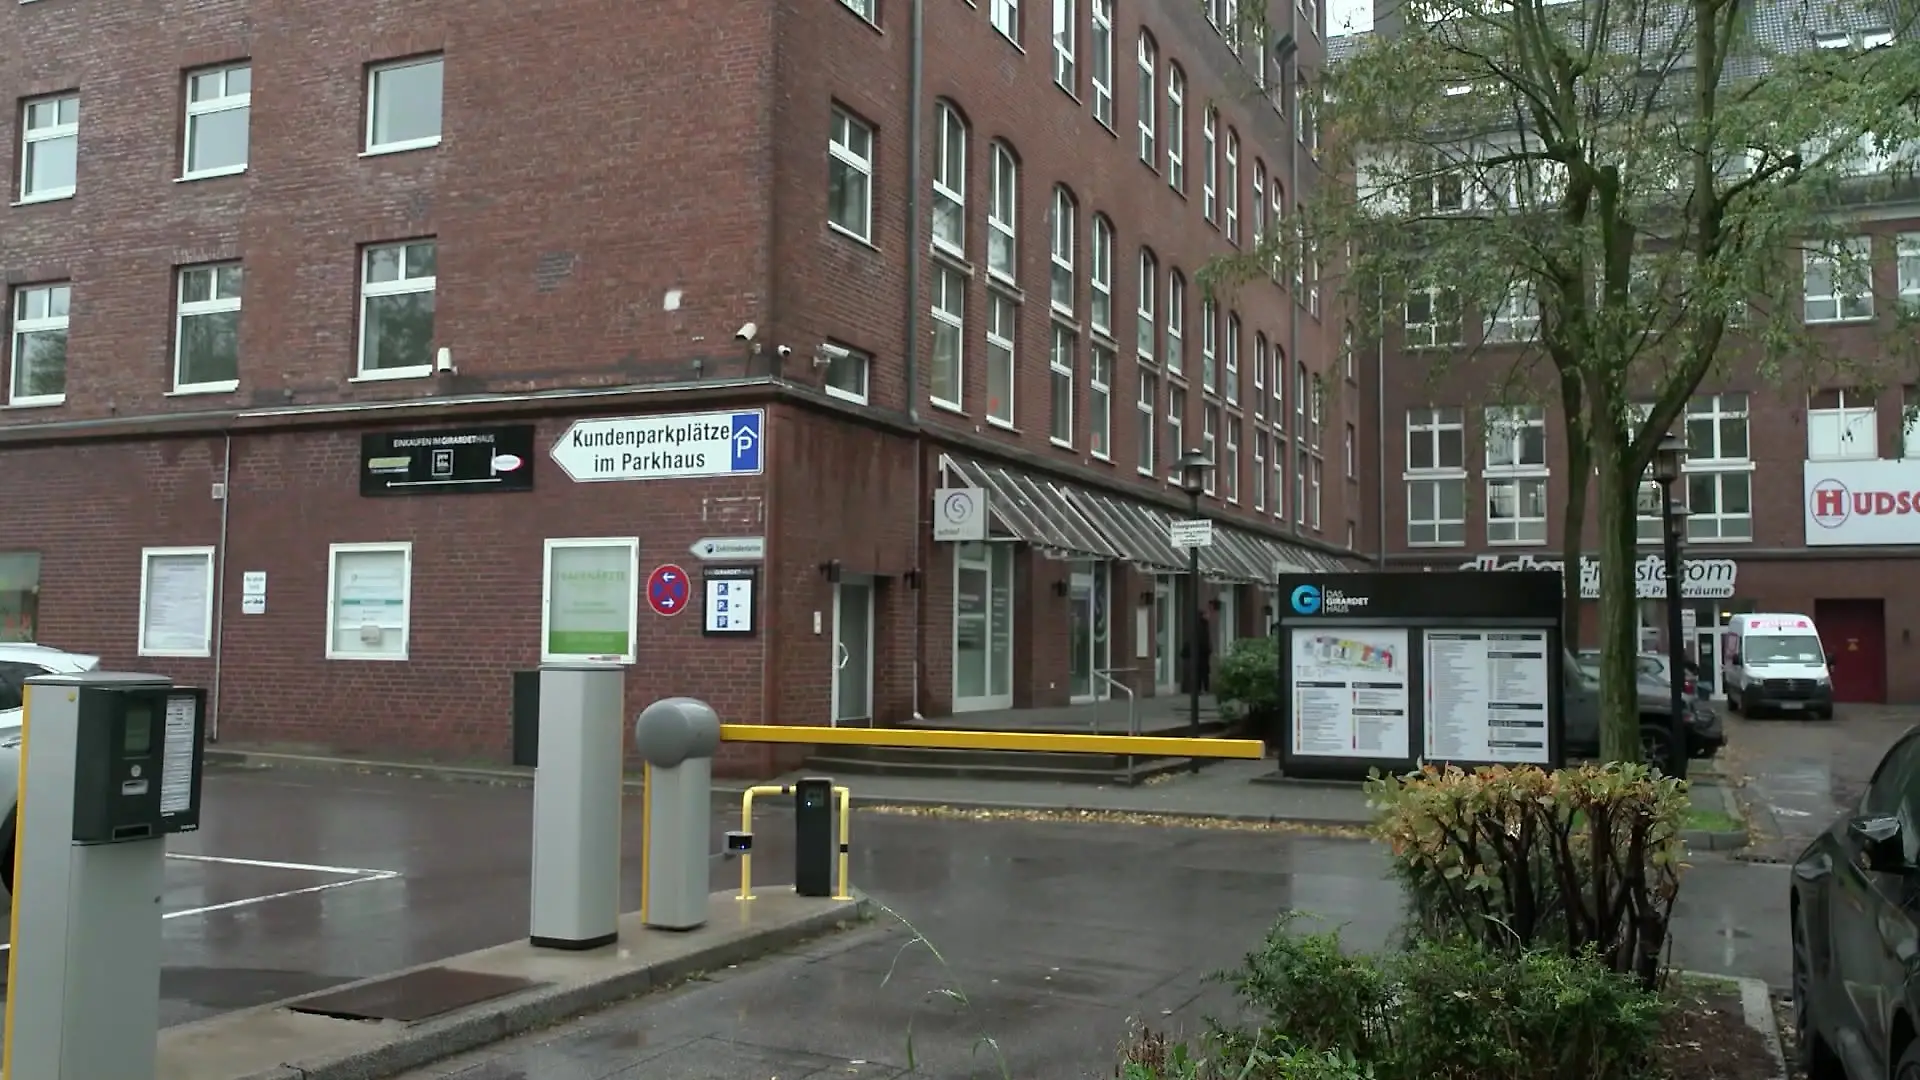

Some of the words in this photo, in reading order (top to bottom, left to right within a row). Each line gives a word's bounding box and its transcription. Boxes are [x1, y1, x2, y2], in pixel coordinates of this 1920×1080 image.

[573, 423, 730, 448] Kundenparkplätze
[594, 455, 614, 472] im
[622, 451, 705, 472] Parkhaus
[1325, 590, 1344, 598] DAS
[1325, 597, 1369, 606] GIRARDET
